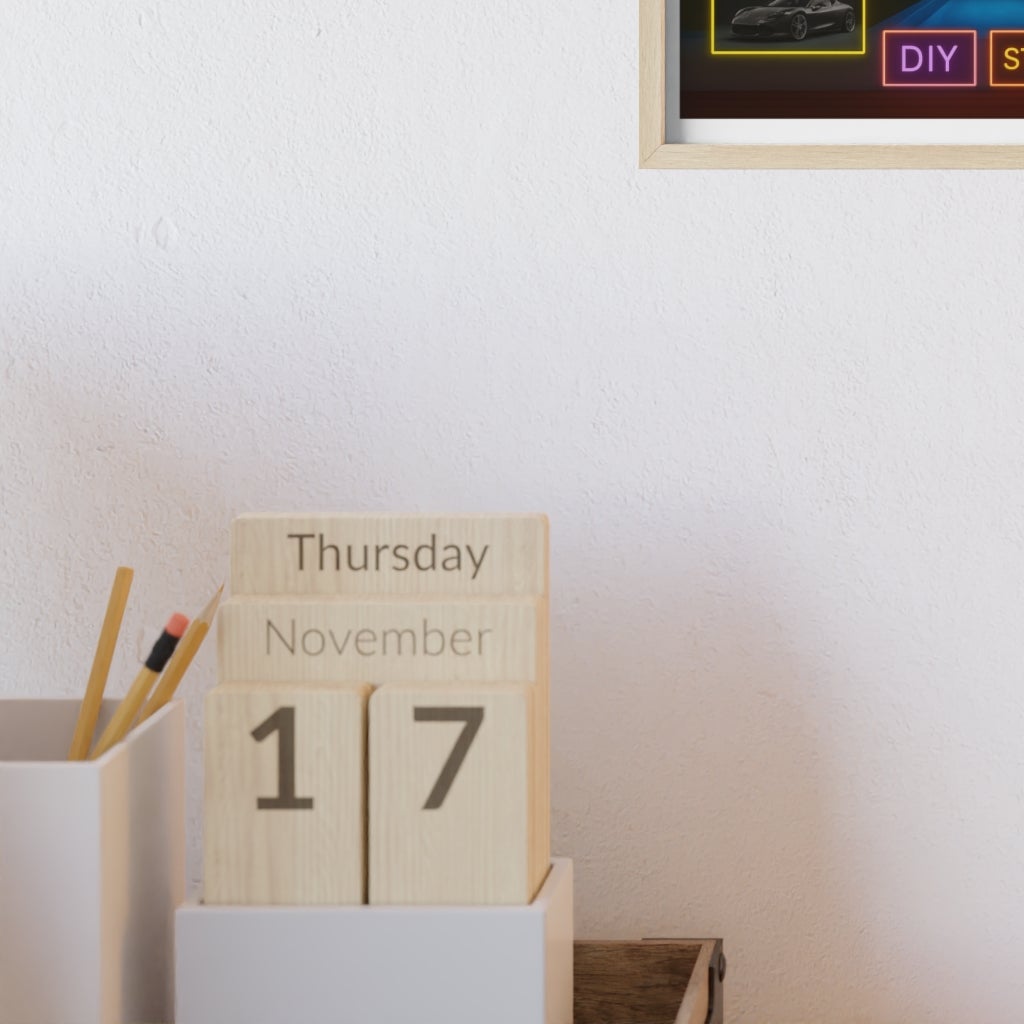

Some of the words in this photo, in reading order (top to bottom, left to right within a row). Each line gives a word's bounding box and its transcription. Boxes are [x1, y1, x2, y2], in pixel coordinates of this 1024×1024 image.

[900, 45, 959, 73] DIY
[287, 533, 490, 580] Thursday
[265, 618, 493, 657] November
